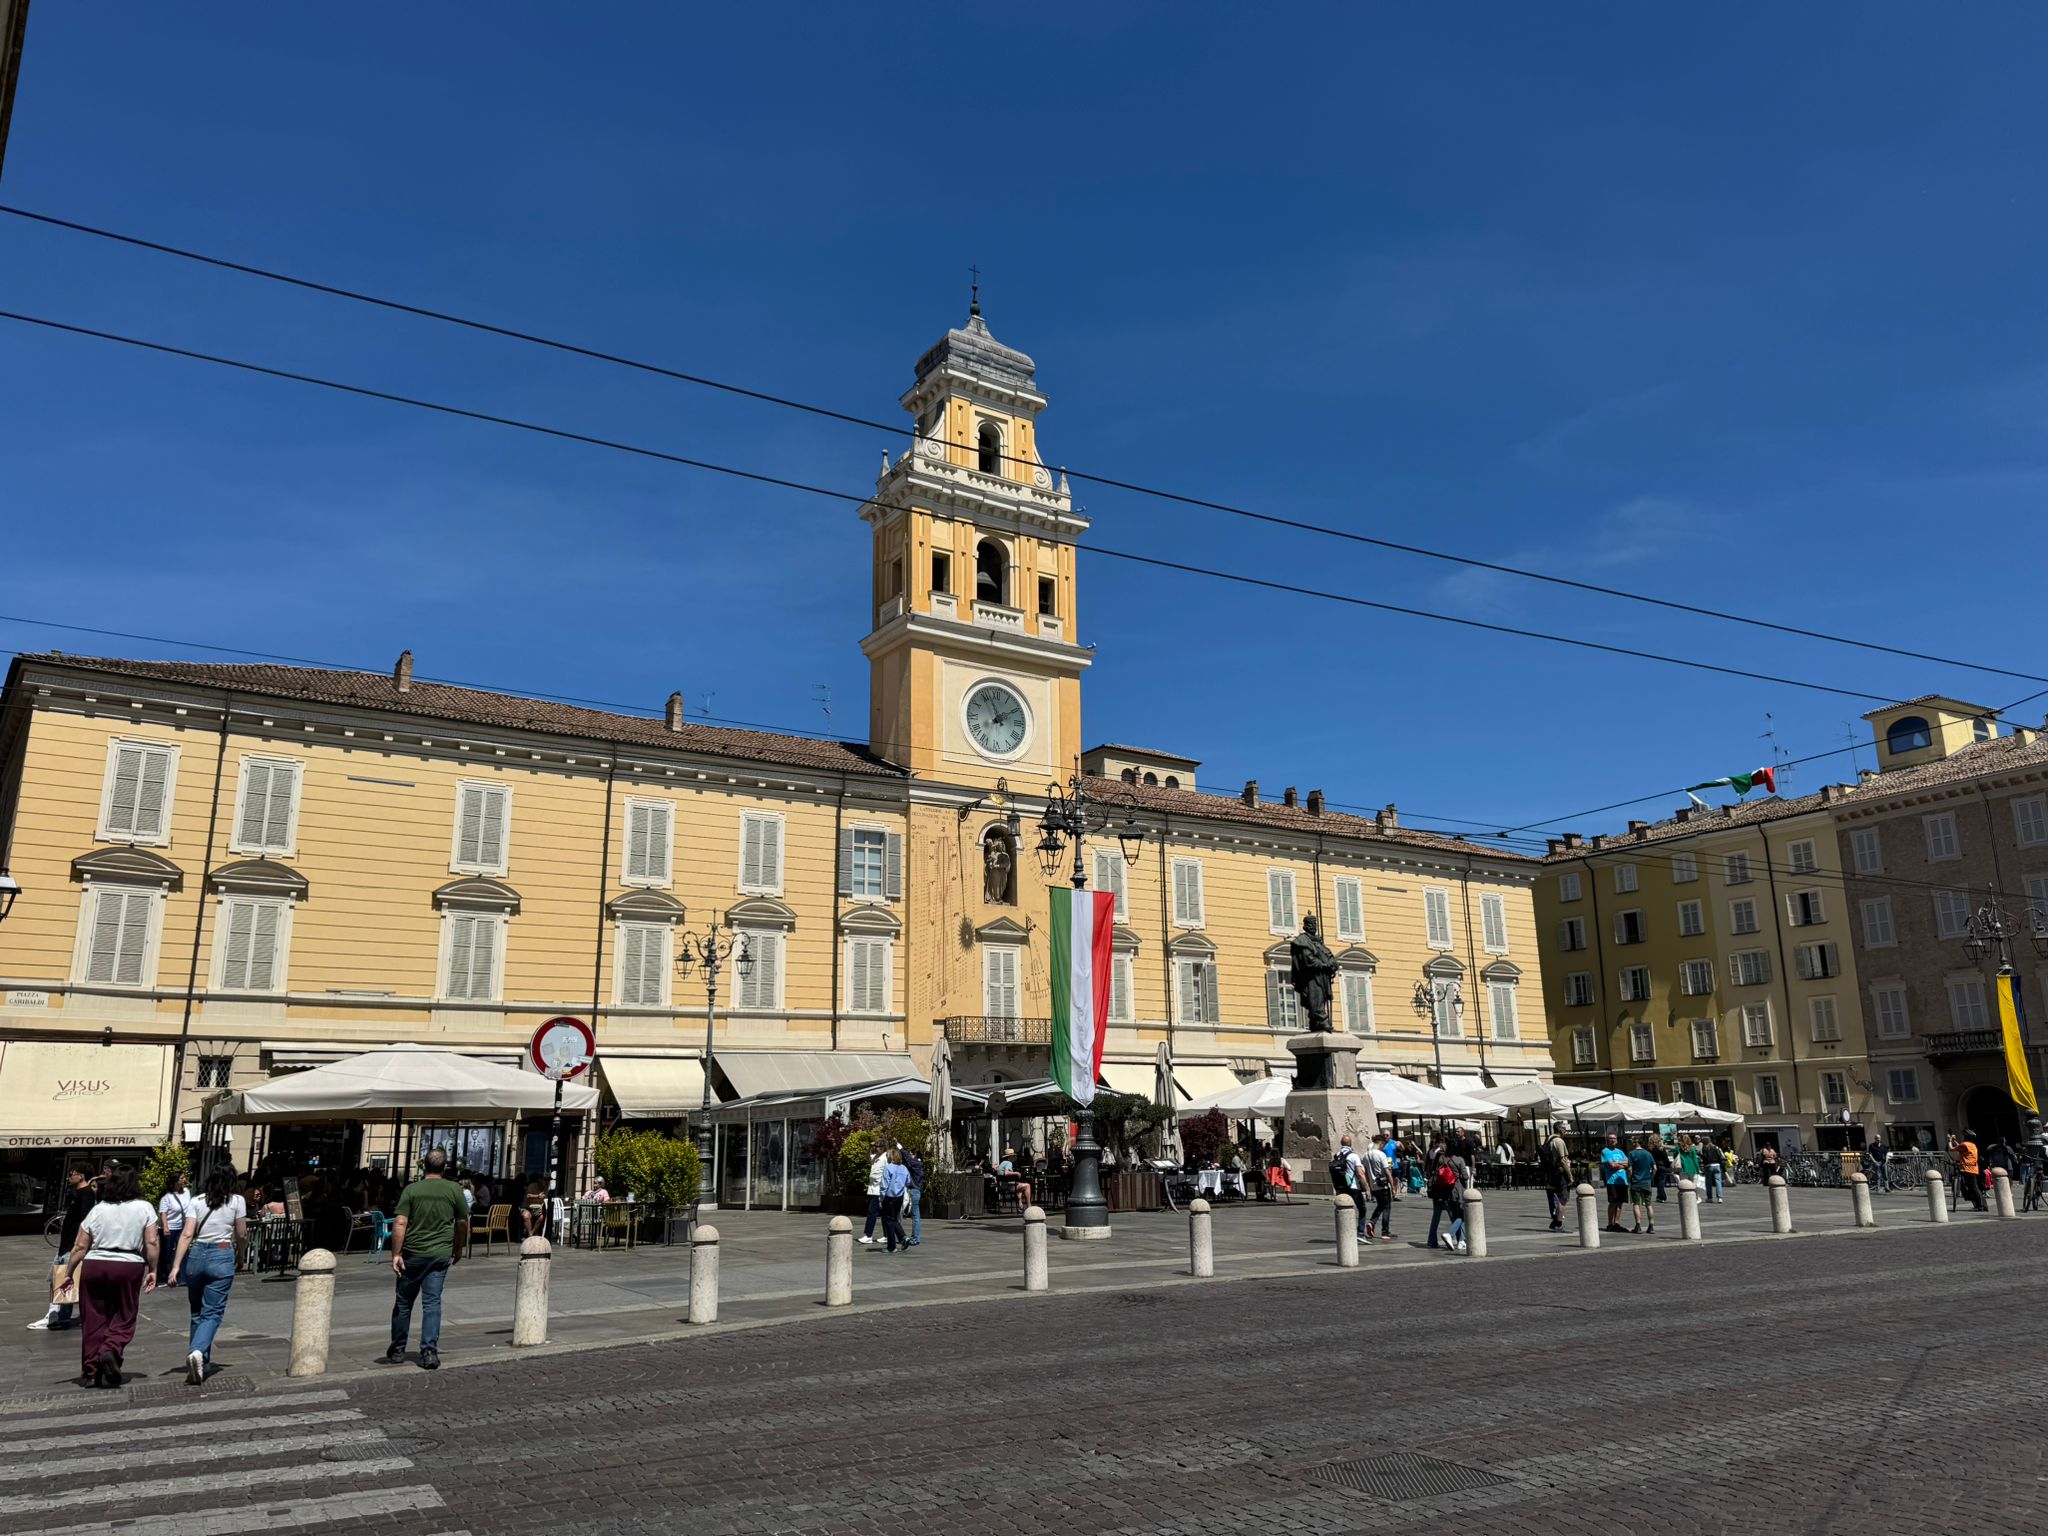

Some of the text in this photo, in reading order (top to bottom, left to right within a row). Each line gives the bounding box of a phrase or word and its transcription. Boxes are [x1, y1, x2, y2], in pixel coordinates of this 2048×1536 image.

[9, 998, 45, 1006] GARIBALDI
[57, 1079, 110, 1091] VISUS
[9, 1137, 51, 1146] OTTICA
[63, 1136, 136, 1146] OPTOMETRIA
